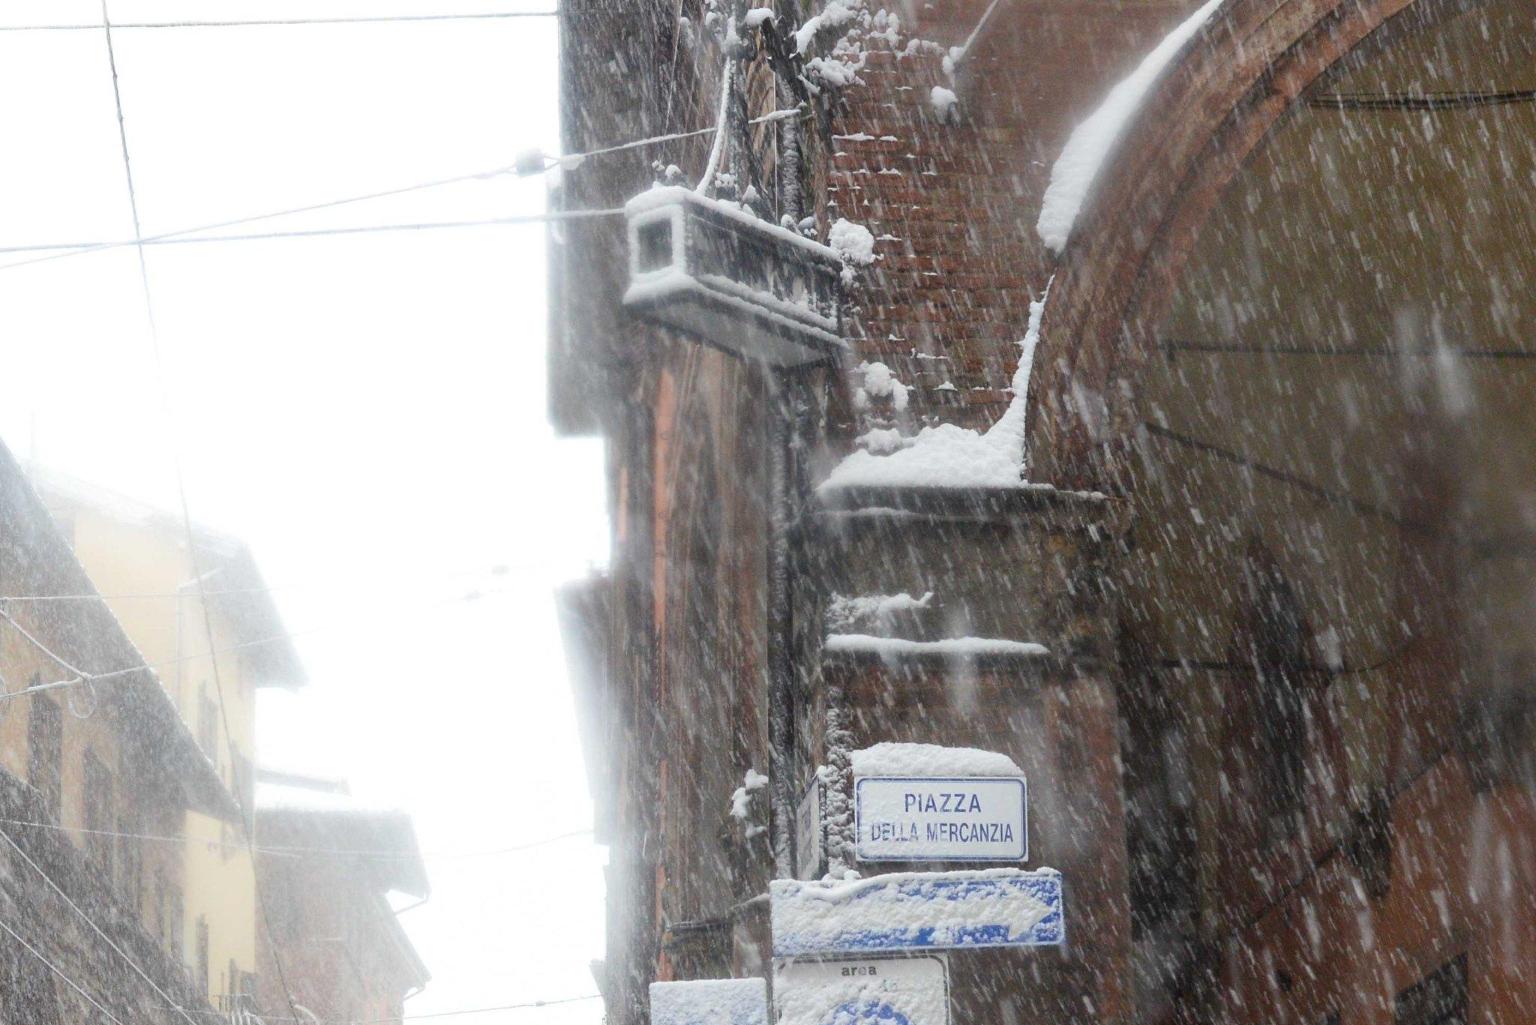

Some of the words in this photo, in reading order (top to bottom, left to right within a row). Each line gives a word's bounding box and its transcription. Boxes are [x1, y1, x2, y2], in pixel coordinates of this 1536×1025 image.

[904, 793, 982, 813] PIAZZA
[871, 821, 919, 842] DELLA
[926, 822, 1014, 843] MERCANZIA
[841, 965, 877, 977] area
